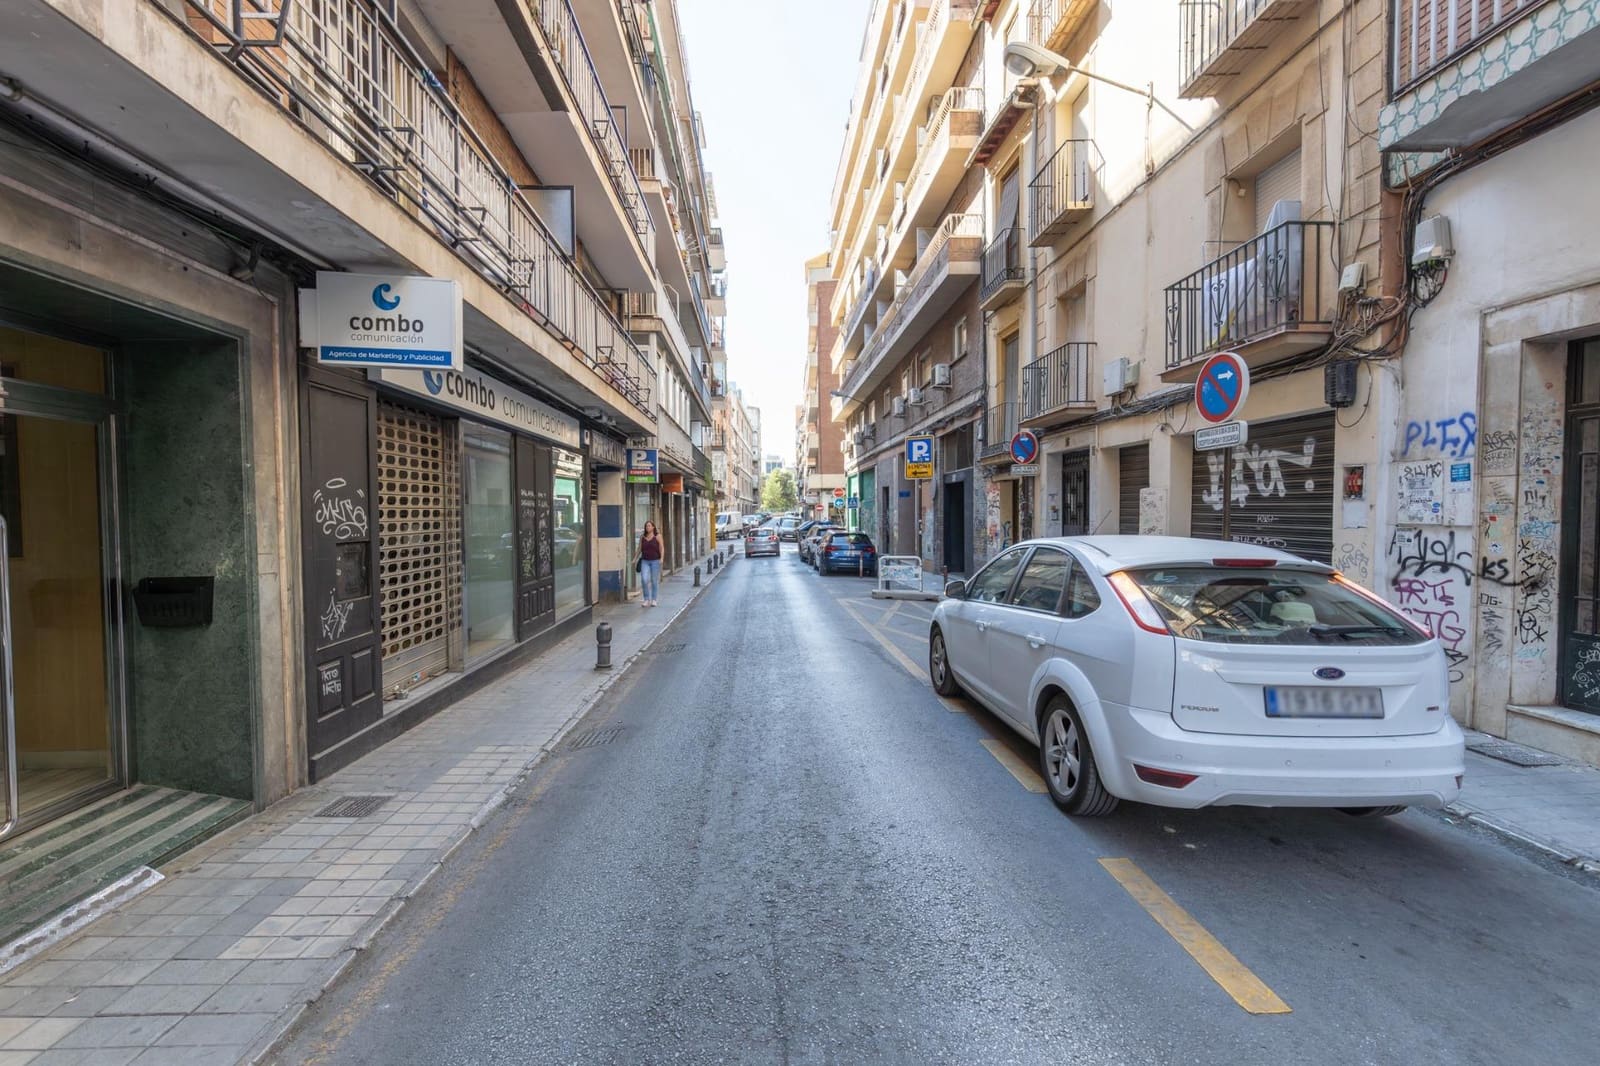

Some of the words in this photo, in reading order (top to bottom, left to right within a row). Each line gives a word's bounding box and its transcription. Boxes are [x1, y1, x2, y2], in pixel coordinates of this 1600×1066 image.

[349, 314, 424, 333] combo
[350, 332, 424, 345] comunicación
[328, 350, 357, 359] Agencia
[358, 351, 367, 359] de
[368, 352, 402, 362] Marketing
[409, 354, 445, 362] Publicidad
[446, 370, 495, 410] combo
[502, 395, 567, 439] comunicación
[912, 441, 928, 461] P
